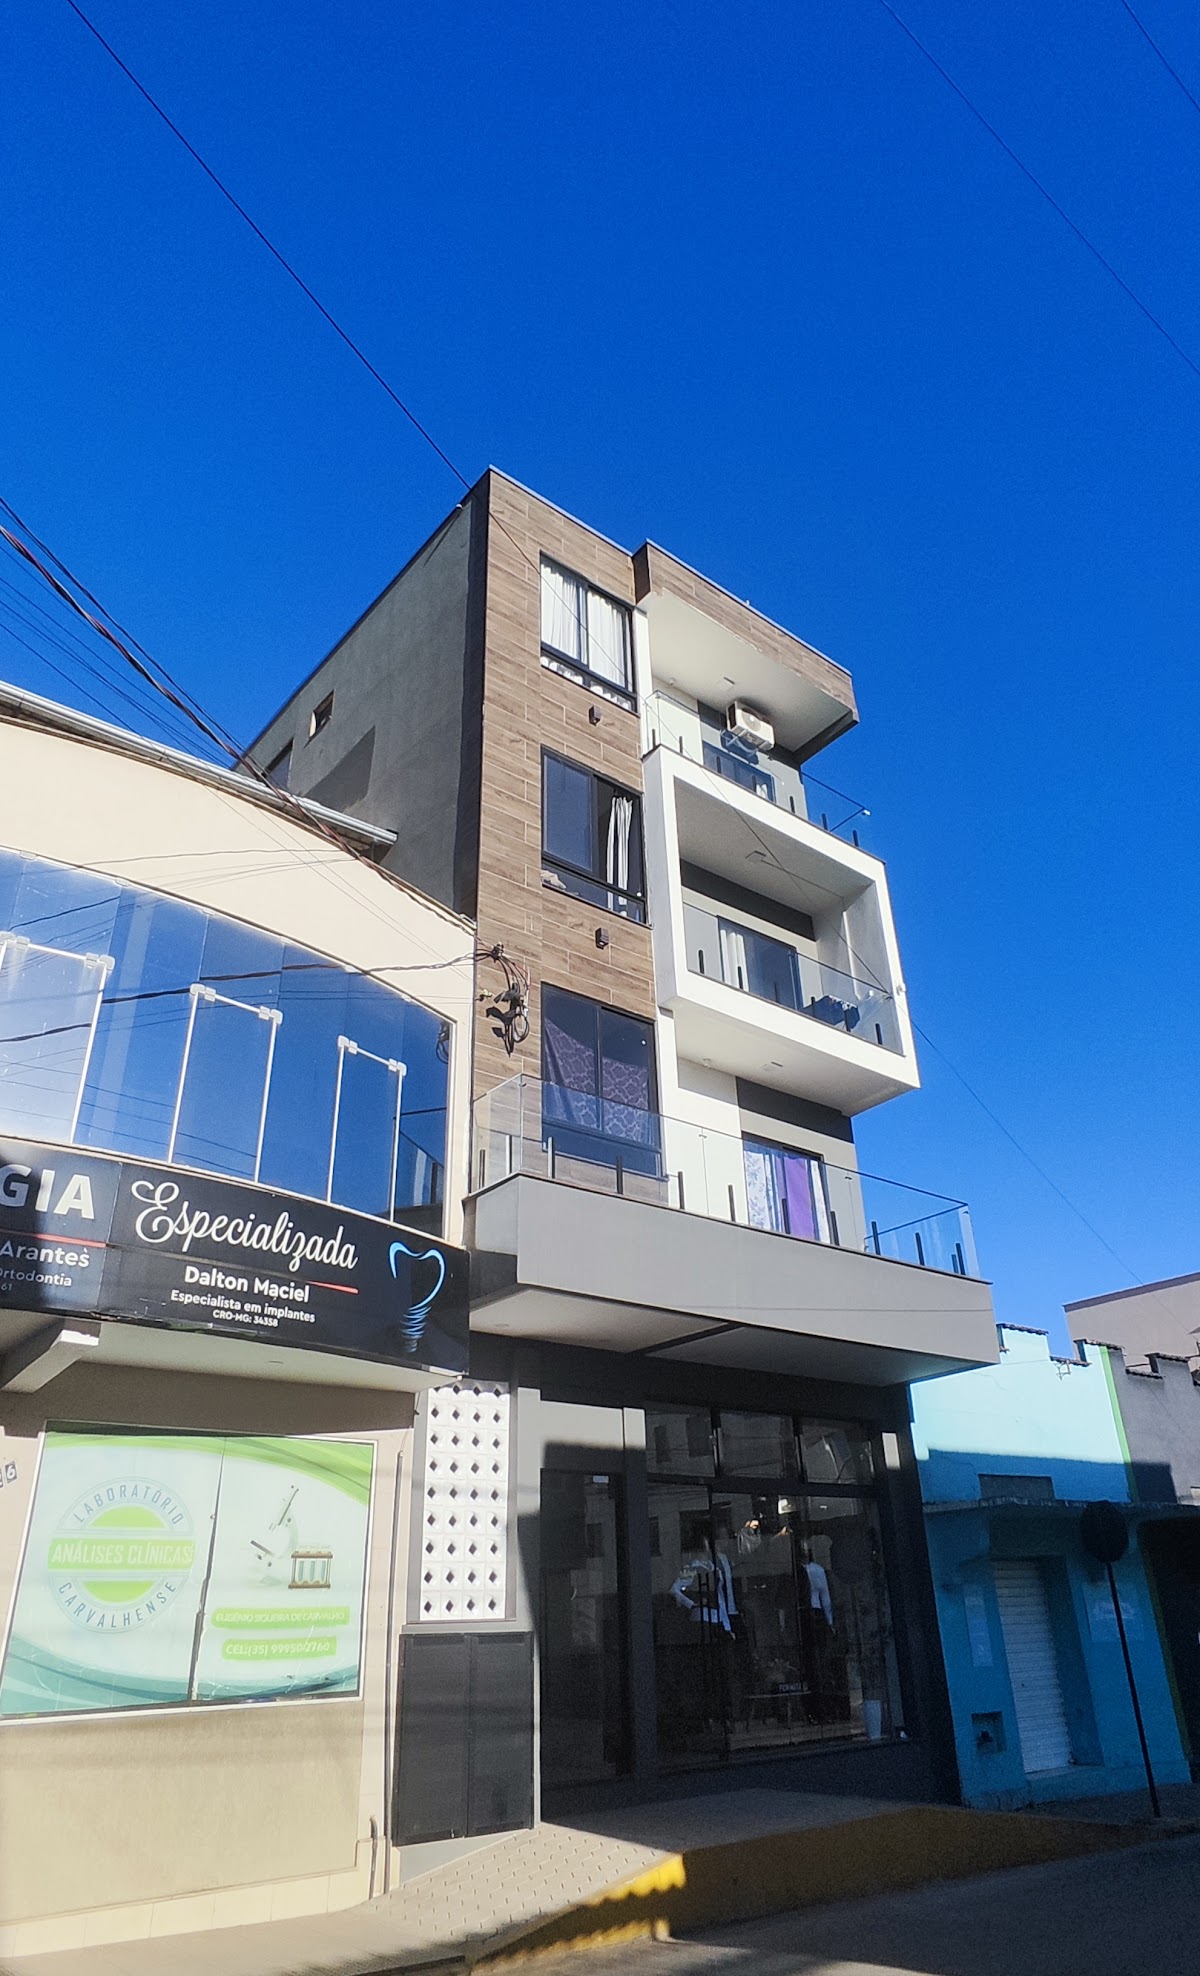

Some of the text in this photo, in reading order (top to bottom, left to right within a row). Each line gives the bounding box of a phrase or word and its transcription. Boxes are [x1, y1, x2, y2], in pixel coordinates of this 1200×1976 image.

[0, 1163, 95, 1220] GIA
[131, 1181, 359, 1272] Especializada
[0, 1240, 90, 1268] Arantes
[184, 1265, 310, 1303] Dalton Maciel
[171, 1289, 316, 1323] Especialista em implantes
[212, 1310, 252, 1323] CRO-MG:
[73, 1484, 184, 1524] LABORATÓRIO
[51, 1541, 193, 1565] ANÁLISES CLÍNICAS
[58, 1581, 176, 1628] CARVALHENSE
[291, 1613, 301, 1622] DE
[302, 1611, 345, 1621] CARVALHO
